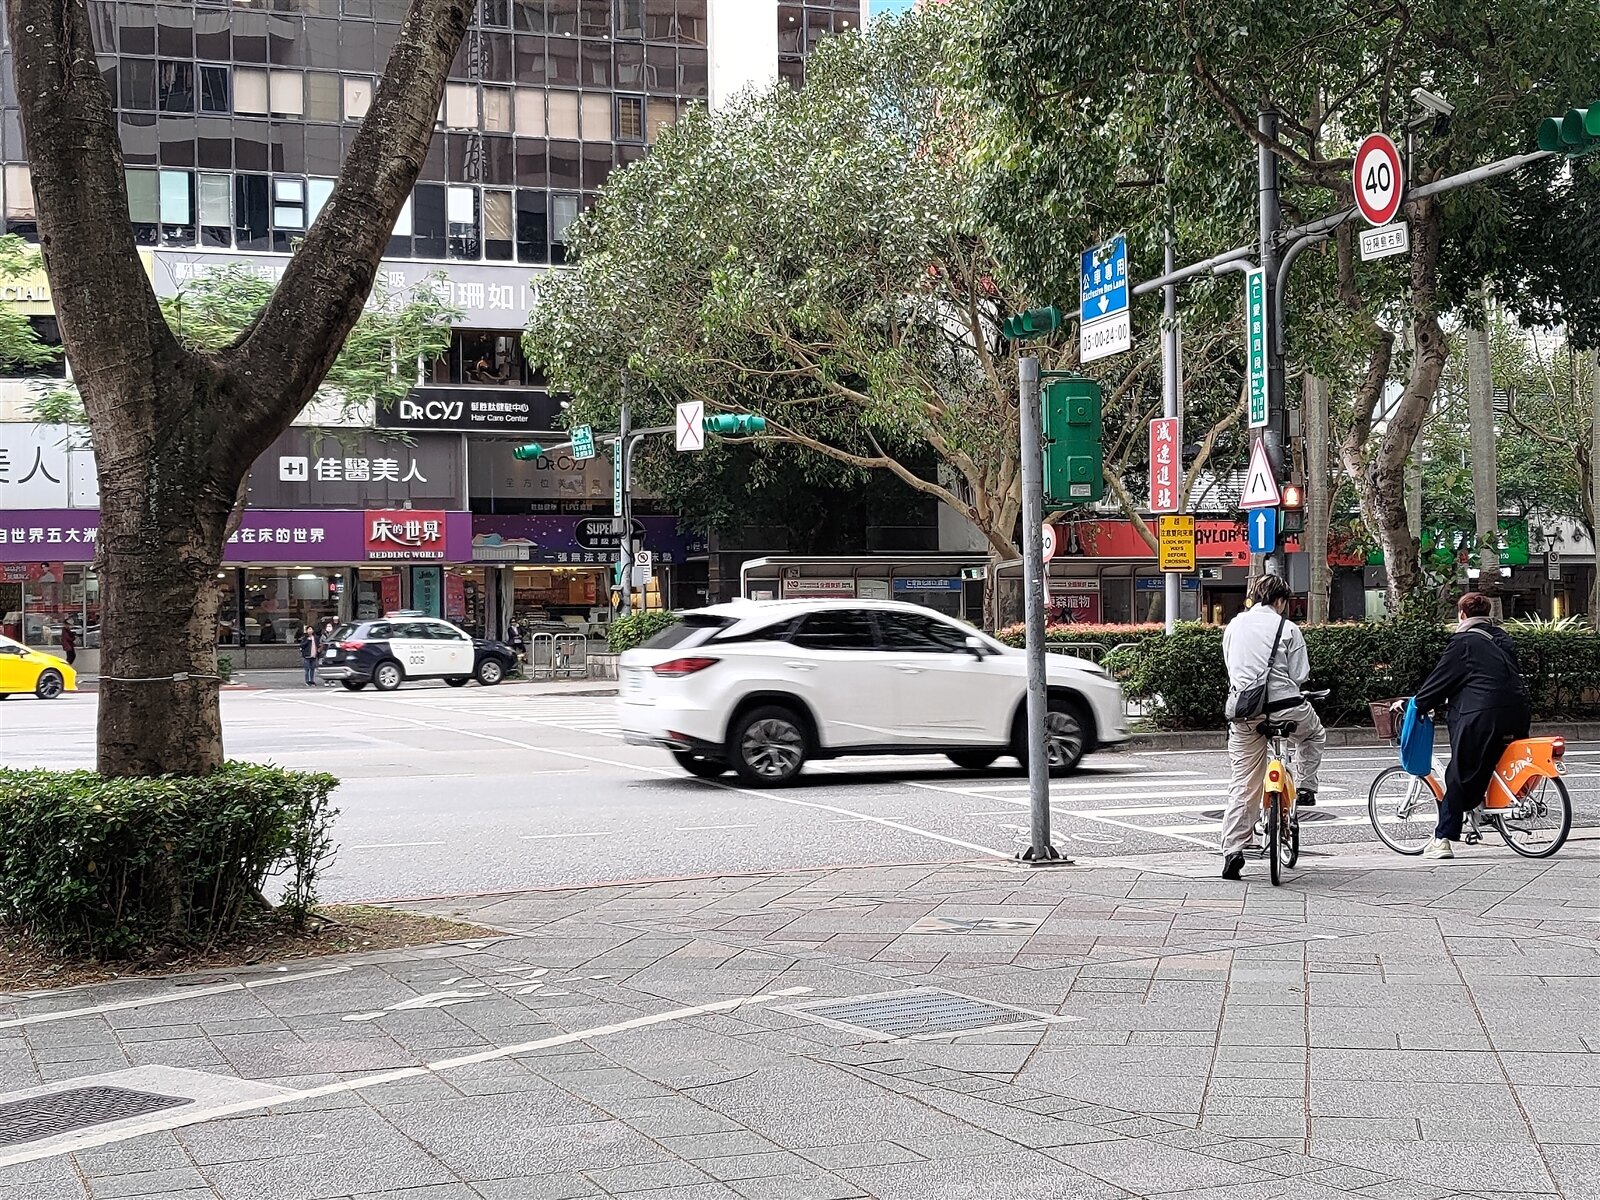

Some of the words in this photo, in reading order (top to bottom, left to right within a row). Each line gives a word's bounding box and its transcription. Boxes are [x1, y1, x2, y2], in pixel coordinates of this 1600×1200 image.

[1366, 163, 1390, 193] 40
[1366, 233, 1402, 251] 分隔島右側
[1083, 258, 1125, 290] 公車專用
[1083, 287, 1104, 302] Exclusive
[1103, 281, 1113, 294] Bus
[1113, 278, 1125, 291] Lane
[471, 414, 485, 422] Hair
[487, 414, 504, 422] Care
[505, 415, 528, 423] Center
[0, 446, 60, 484] 人
[313, 457, 428, 483] 佳醫美人
[1157, 421, 1172, 508] 減速進站
[369, 517, 442, 546] 床的世界
[1195, 529, 1237, 545] AYLOR
[369, 551, 410, 559] BEDDING
[411, 551, 444, 559] WORLD
